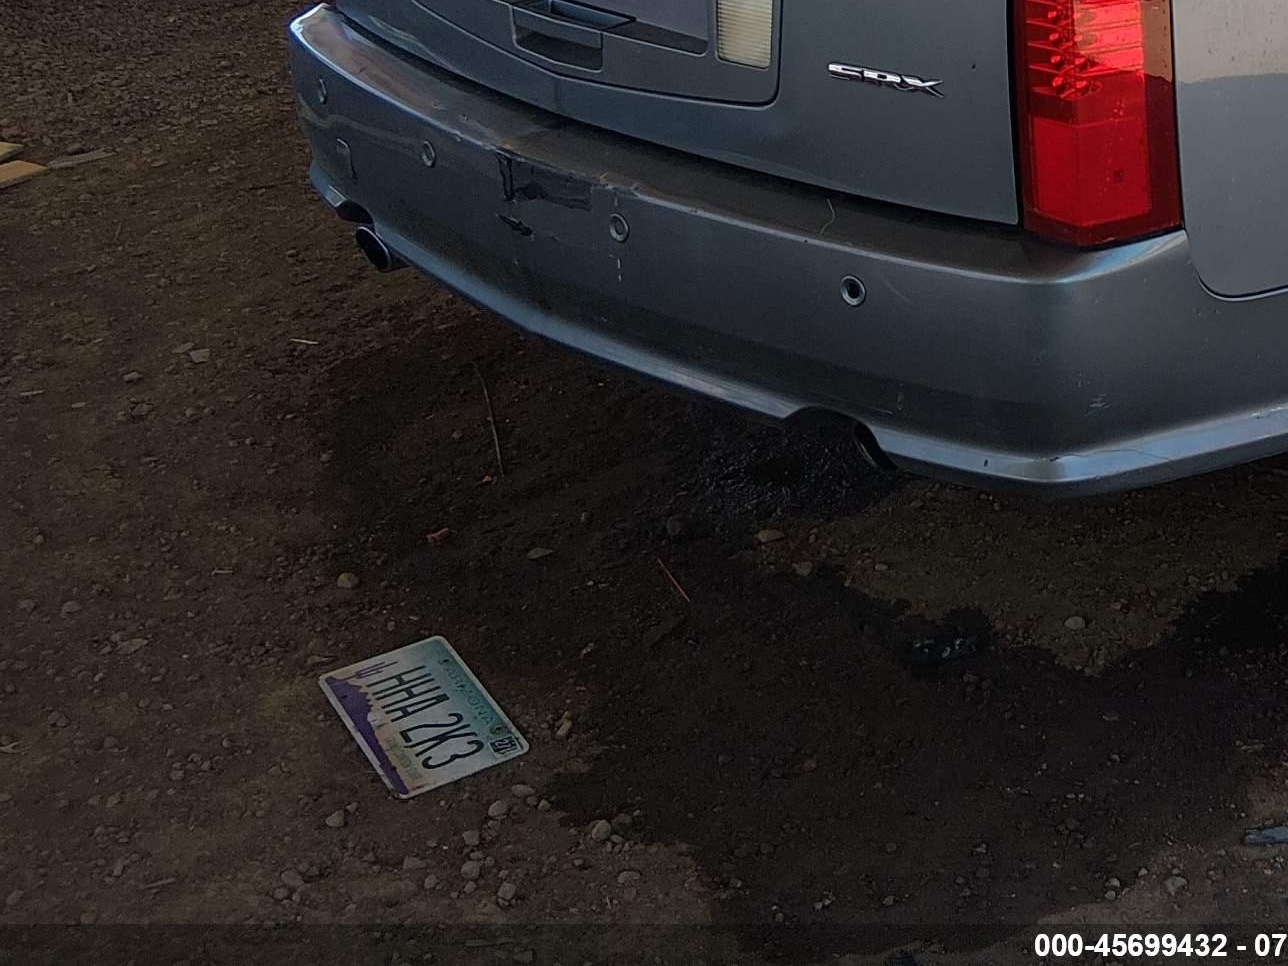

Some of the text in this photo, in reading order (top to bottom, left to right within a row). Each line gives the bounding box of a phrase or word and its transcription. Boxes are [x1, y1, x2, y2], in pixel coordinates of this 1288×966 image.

[366, 665, 450, 723] HHA
[442, 663, 497, 726] ARIZONA
[399, 712, 485, 770] 2K3
